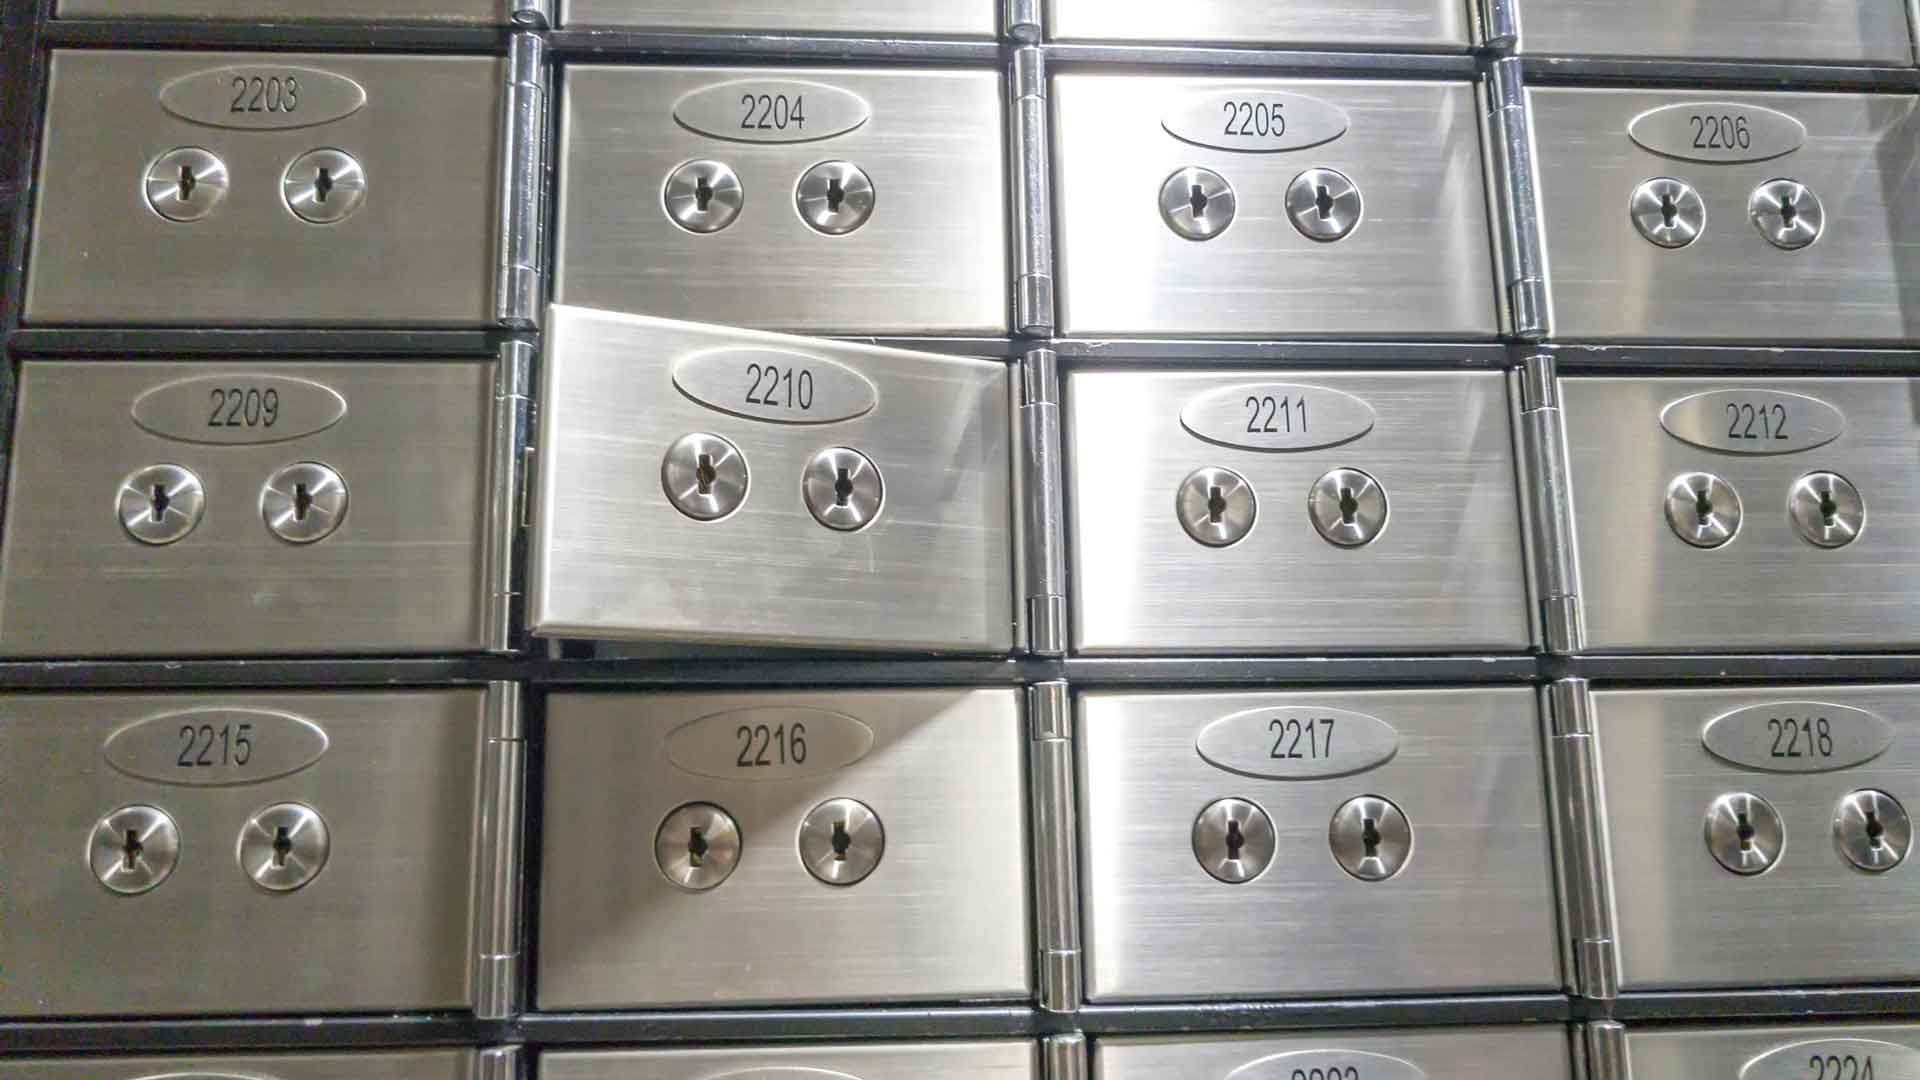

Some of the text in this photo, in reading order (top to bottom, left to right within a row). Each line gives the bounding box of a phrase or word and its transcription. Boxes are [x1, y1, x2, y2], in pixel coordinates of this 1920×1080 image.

[230, 76, 297, 113] 2203
[741, 94, 805, 130] 2204
[1223, 101, 1285, 137] 2205
[1690, 115, 1750, 150] 2206
[745, 363, 813, 410] 2210
[207, 388, 279, 428] 2209
[1245, 396, 1307, 433] 2211
[1728, 403, 1789, 440] 2212
[177, 724, 251, 767] 2215
[736, 723, 807, 768] 2216
[1269, 718, 1335, 759] 2217
[1769, 718, 1831, 758] 2218
